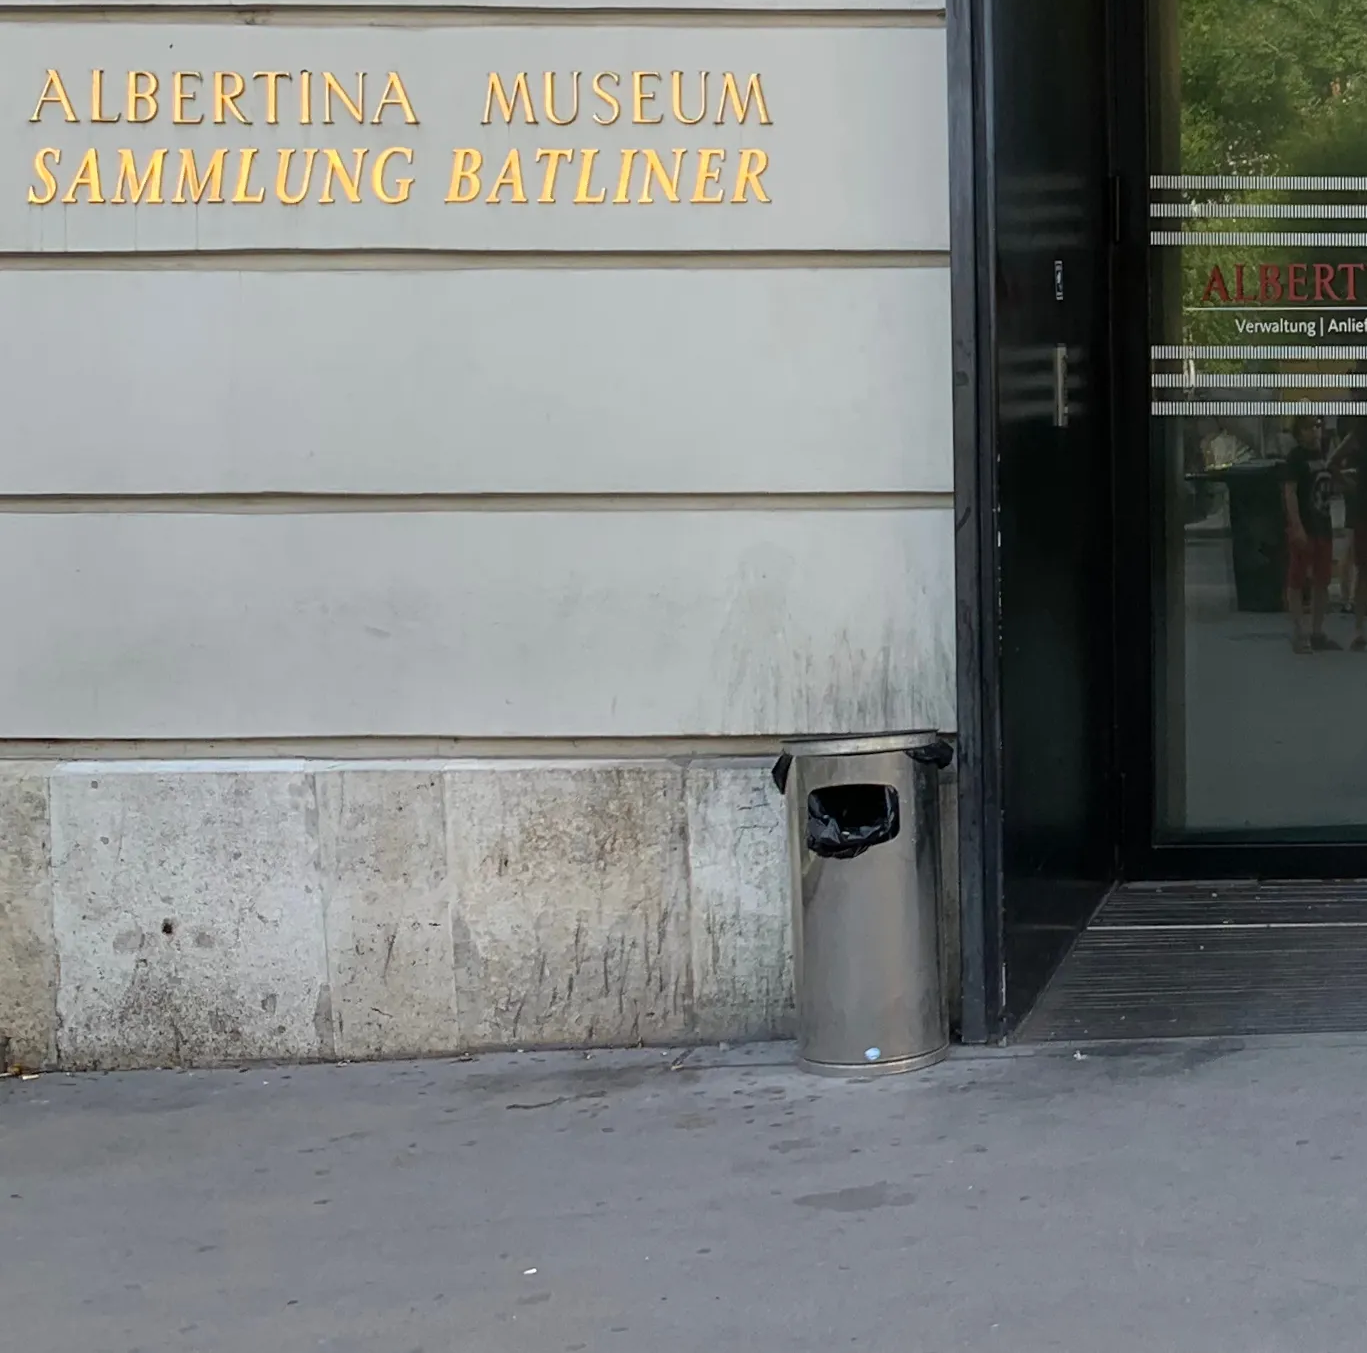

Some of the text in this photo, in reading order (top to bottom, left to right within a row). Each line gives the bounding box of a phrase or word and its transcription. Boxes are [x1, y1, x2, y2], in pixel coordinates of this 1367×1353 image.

[29, 69, 774, 126] ALBERTINA MUSEUM
[27, 146, 772, 204] SAMMLUNG BATLINER
[1235, 318, 1316, 336] Verwaltung
